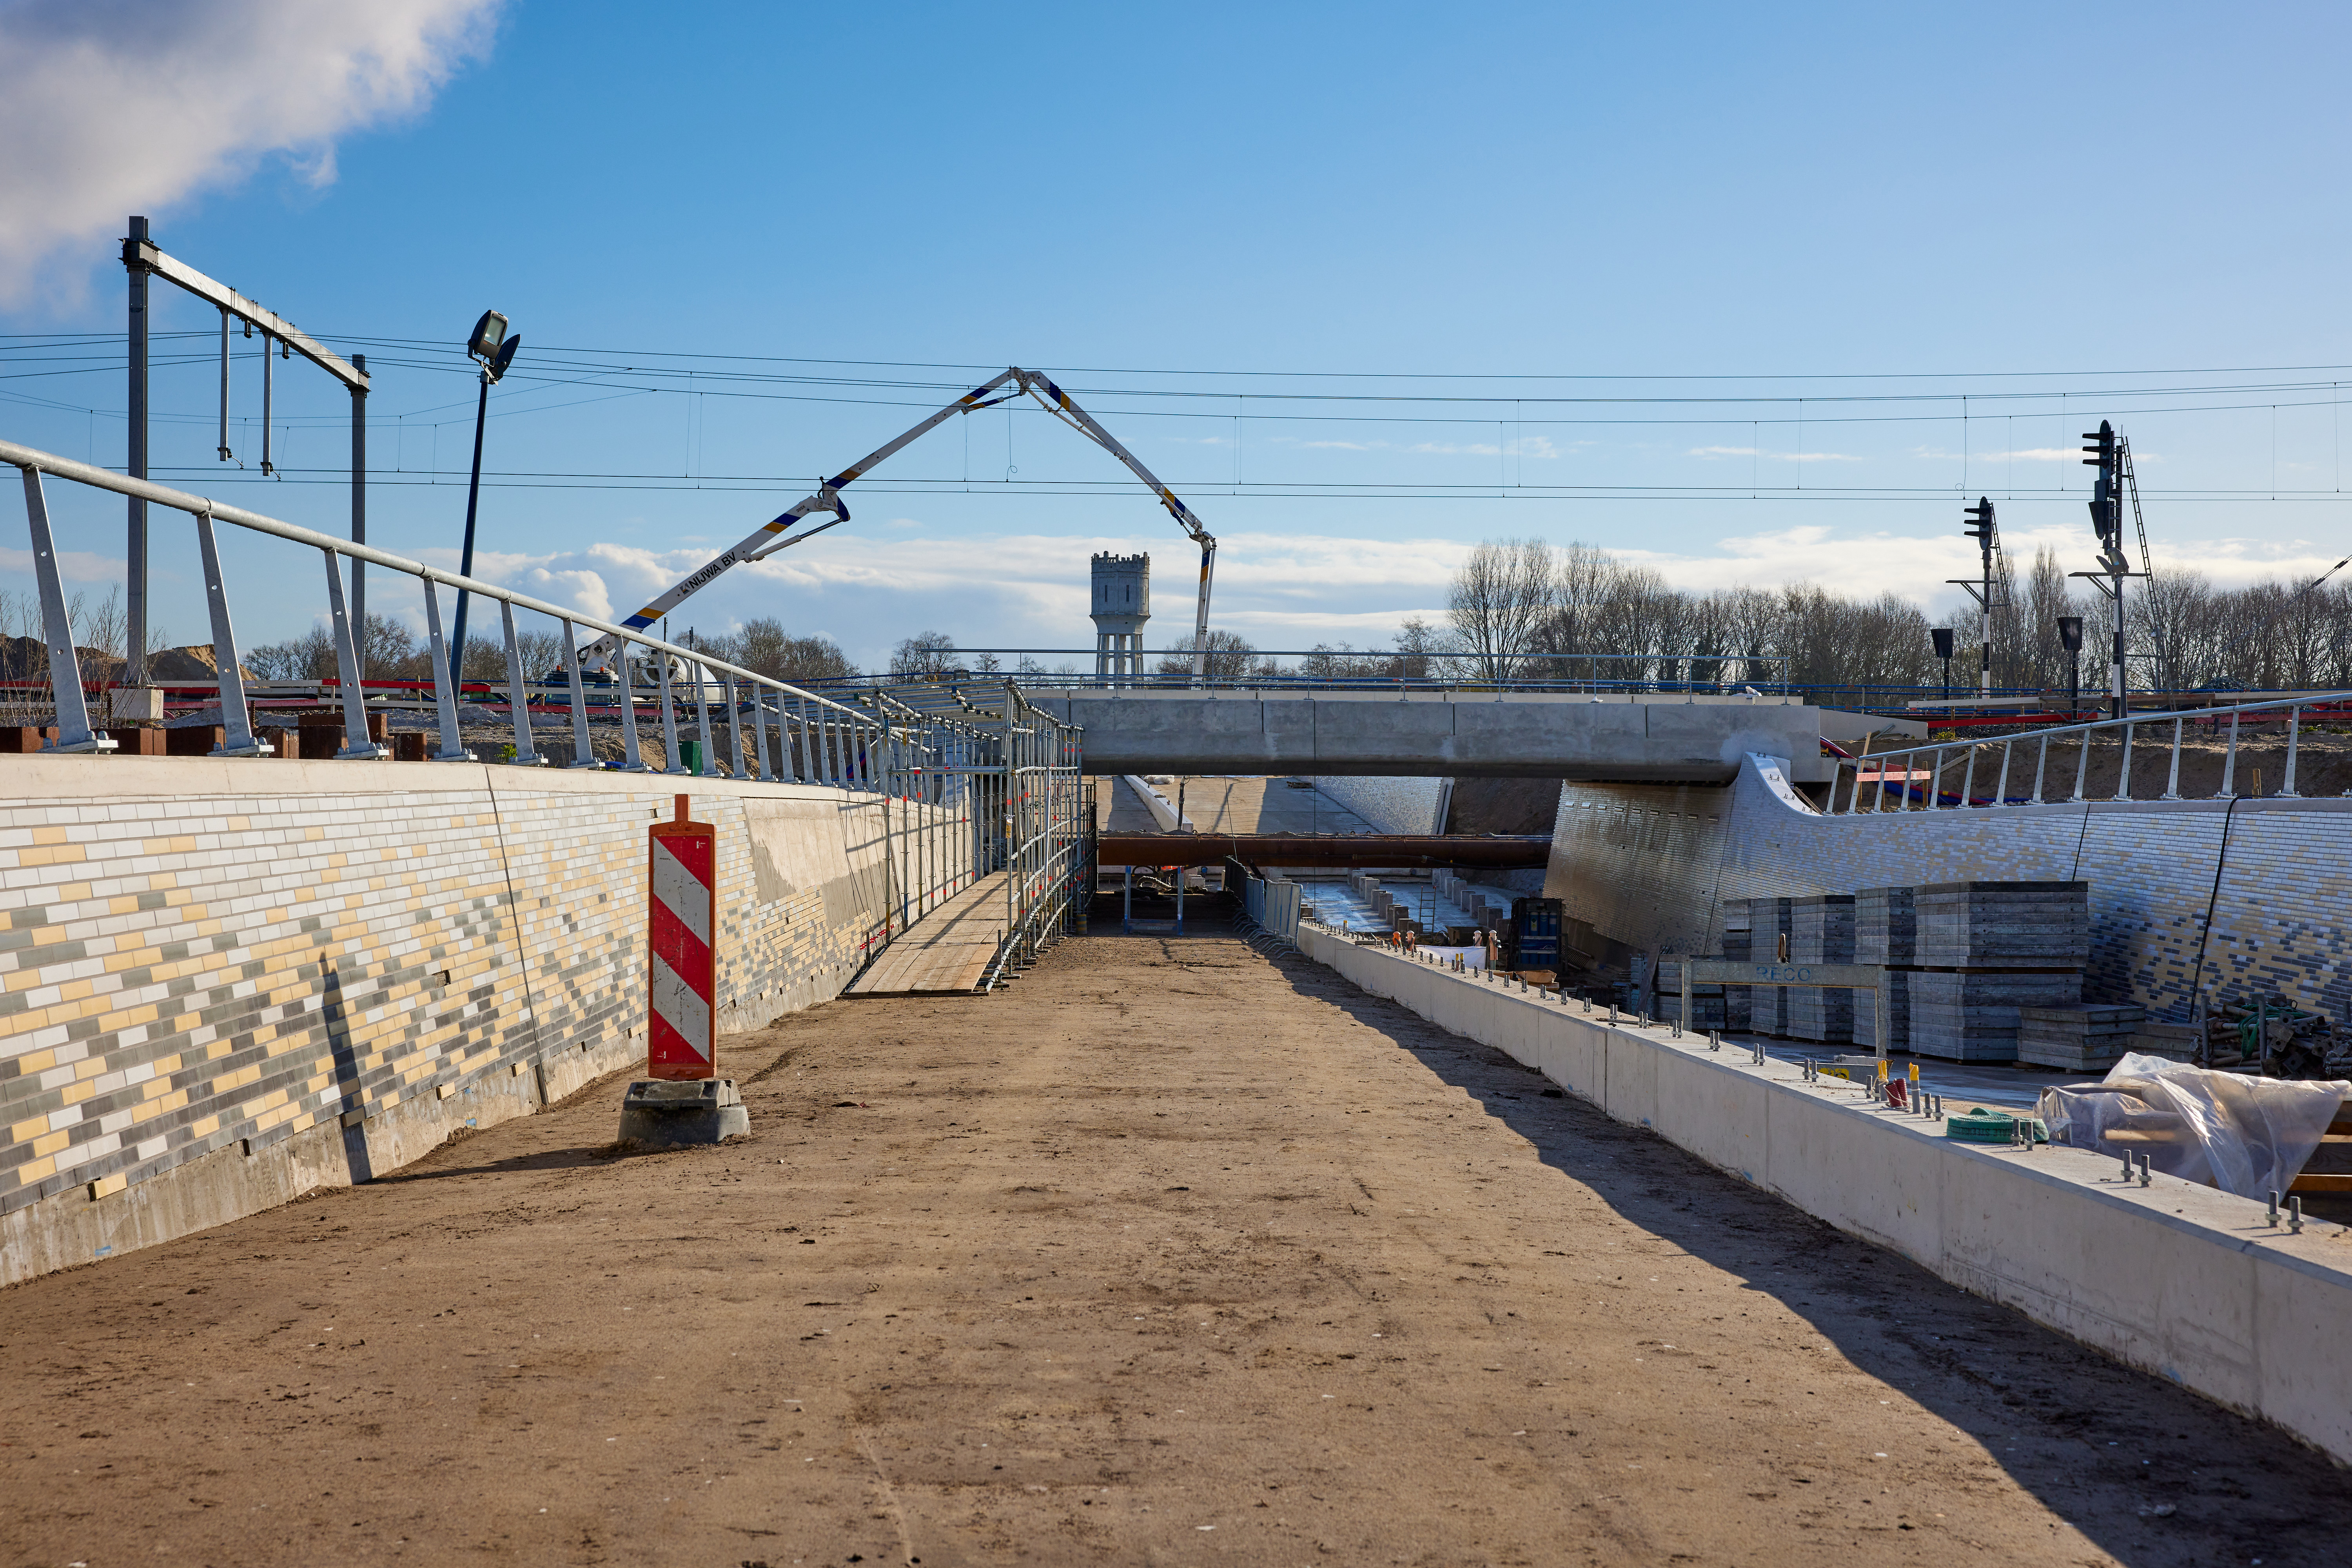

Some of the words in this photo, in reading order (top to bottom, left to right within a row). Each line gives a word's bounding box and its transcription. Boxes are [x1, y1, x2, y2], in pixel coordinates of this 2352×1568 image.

[688, 564, 722, 589] NIJWA
[721, 551, 736, 567] BV
[1757, 967, 1811, 981] RECO
